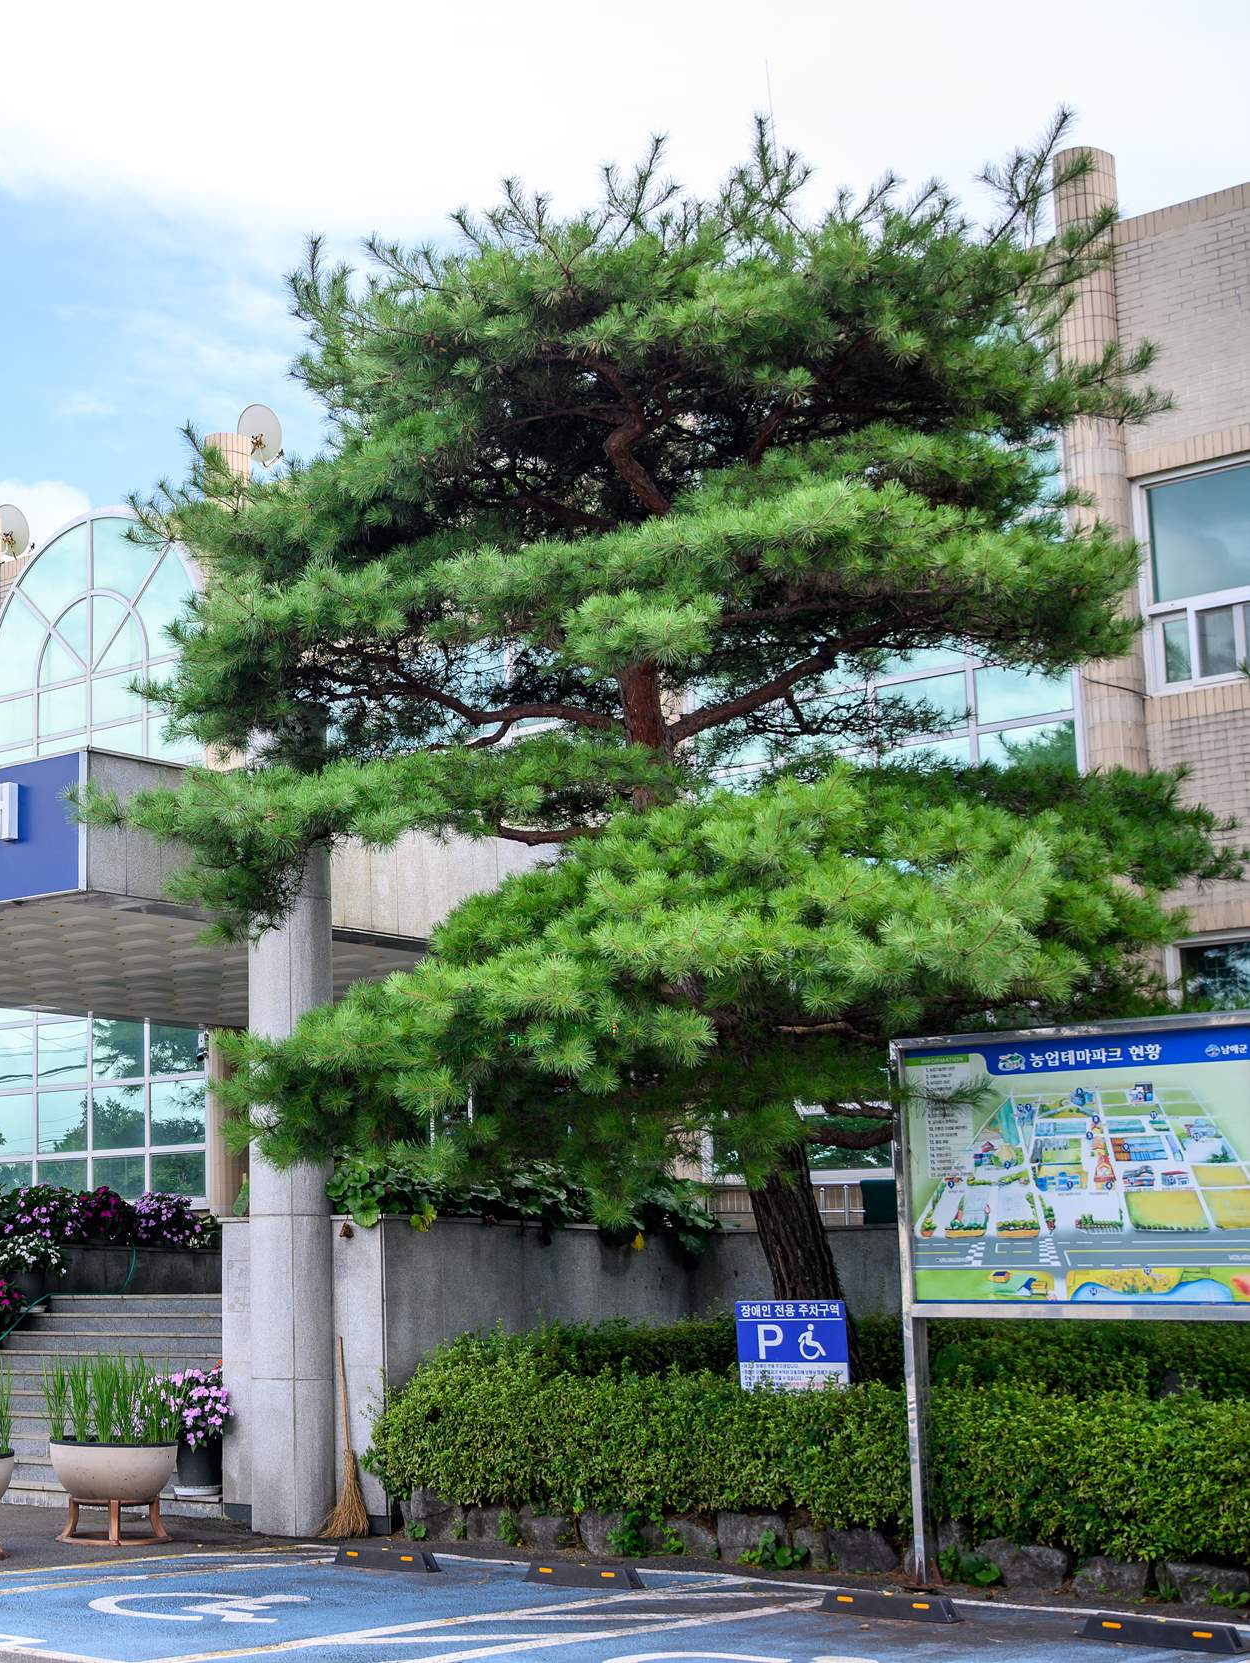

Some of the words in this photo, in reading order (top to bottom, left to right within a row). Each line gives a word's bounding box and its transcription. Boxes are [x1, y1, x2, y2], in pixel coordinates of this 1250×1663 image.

[1029, 1048, 1124, 1069] 농업테마파크
[1128, 1043, 1162, 1061] 현황
[740, 1304, 771, 1317] 장애인
[774, 1304, 795, 1317] 전용
[798, 1303, 840, 1317] 주차구역
[757, 1323, 784, 1360] P
